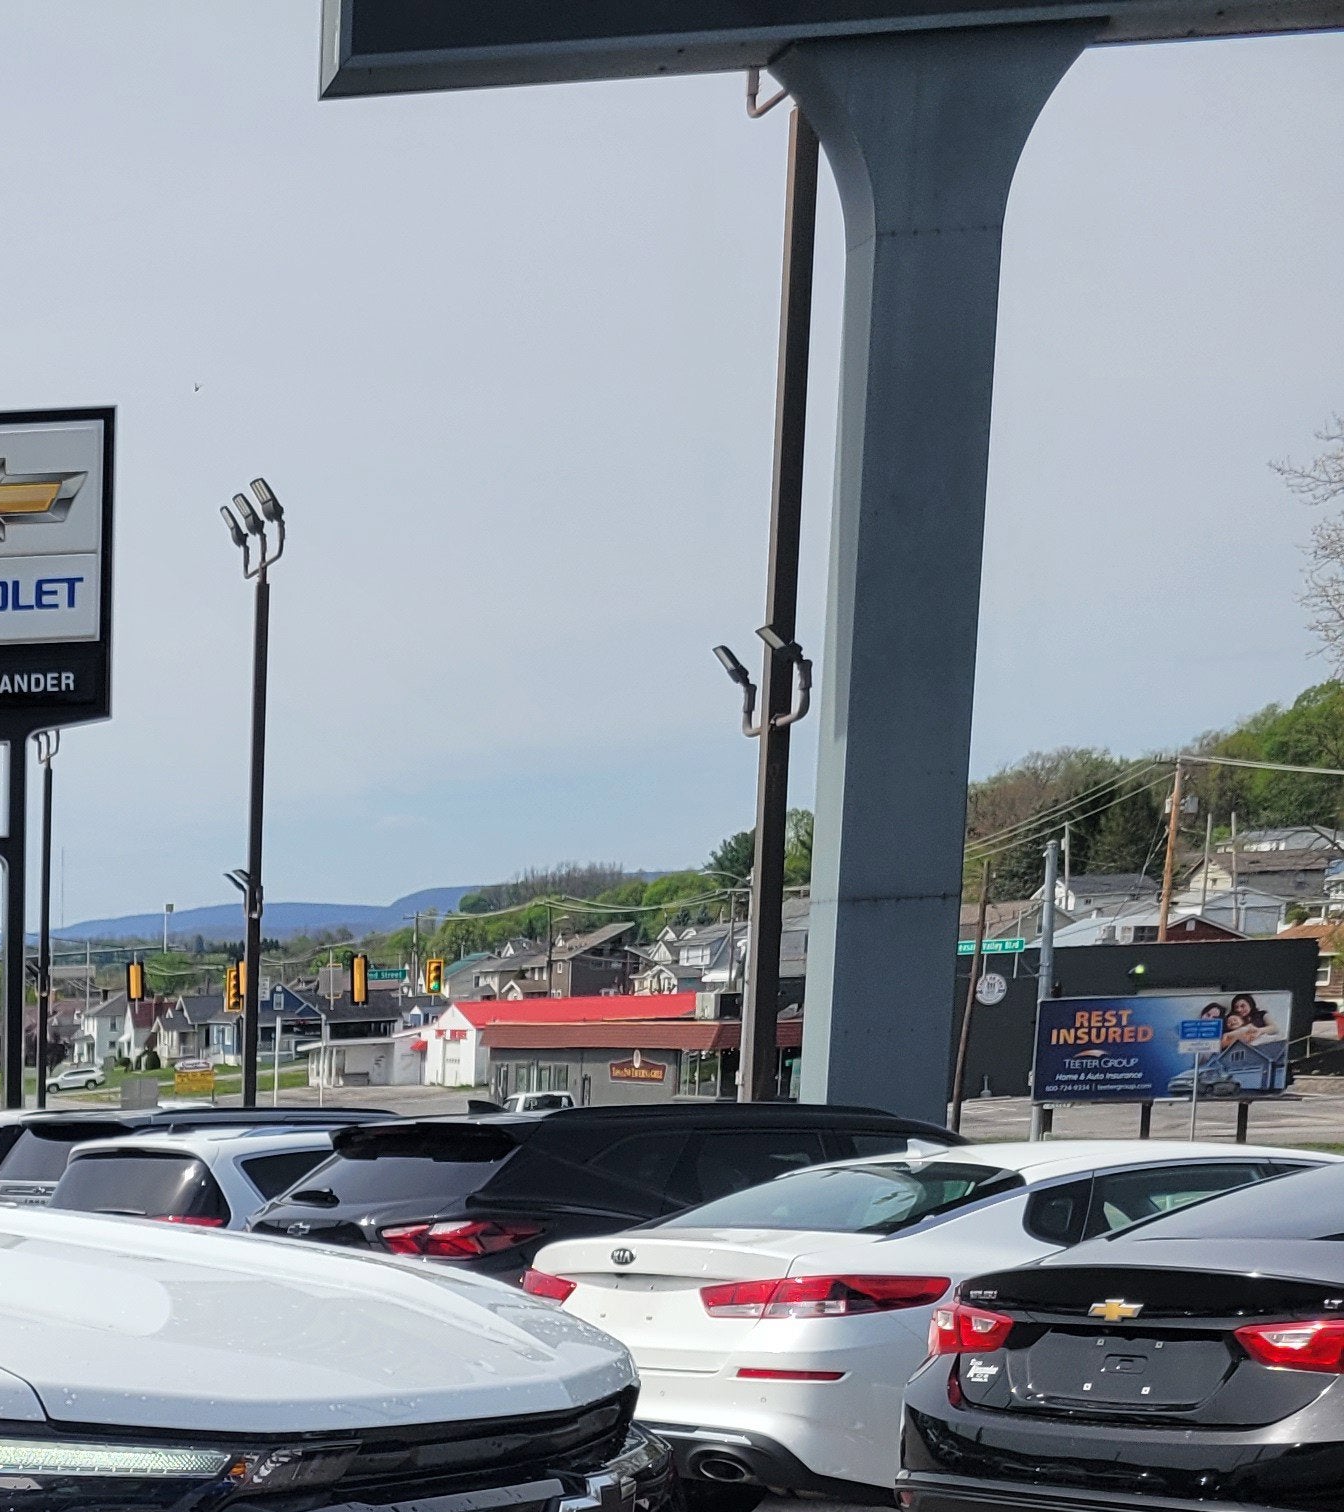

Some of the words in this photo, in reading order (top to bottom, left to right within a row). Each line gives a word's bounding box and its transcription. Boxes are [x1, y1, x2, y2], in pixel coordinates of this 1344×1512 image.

[381, 971, 402, 979] Street
[1075, 1009, 1133, 1028] REST
[1050, 1026, 1154, 1045] INSURED
[1064, 1059, 1099, 1069] TEETER
[1100, 1057, 1139, 1068] GROUP
[1055, 1073, 1079, 1081] Home
[1079, 1073, 1086, 1081] &
[1086, 1072, 1104, 1080] Auto
[1105, 1071, 1144, 1079] Insurance
[613, 1250, 631, 1263] KIA
[1323, 1299, 1344, 1310] LT
